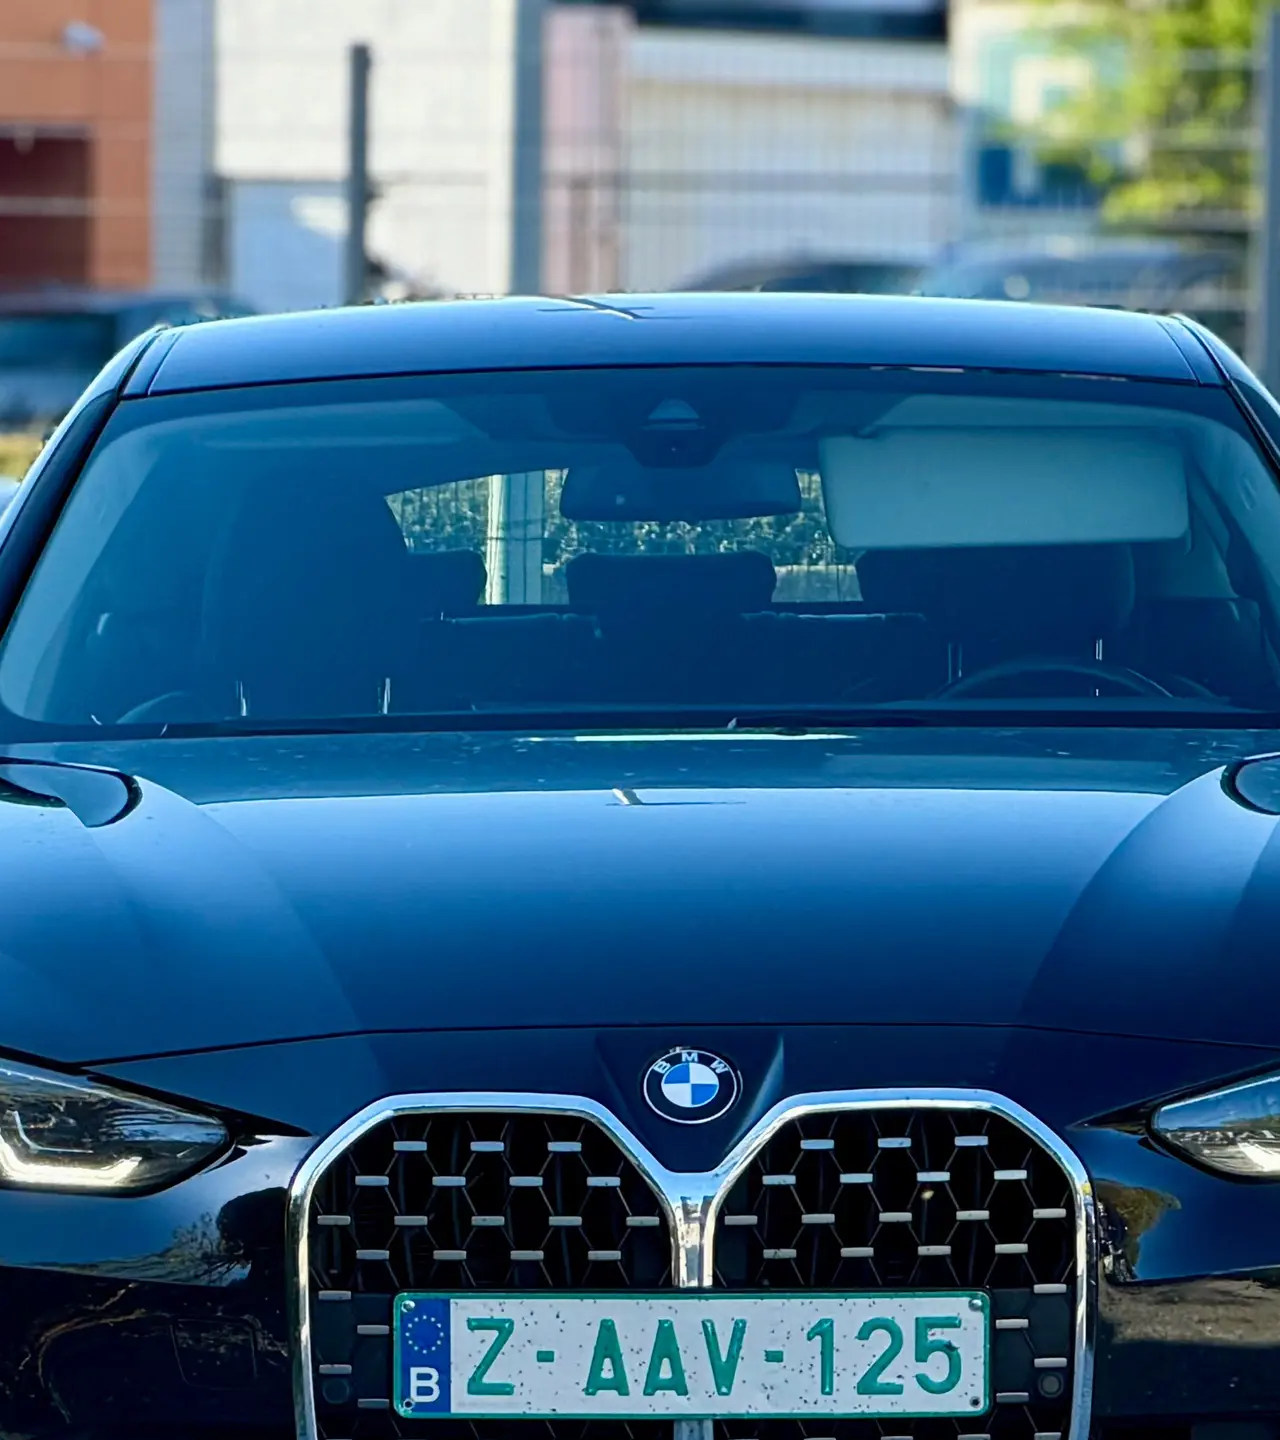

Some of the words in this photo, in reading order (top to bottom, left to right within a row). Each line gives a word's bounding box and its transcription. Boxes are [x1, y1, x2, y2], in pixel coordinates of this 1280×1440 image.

[652, 1052, 730, 1075] BMW
[465, 1315, 963, 1397] Z-AAV-125
[409, 1366, 441, 1403] B
